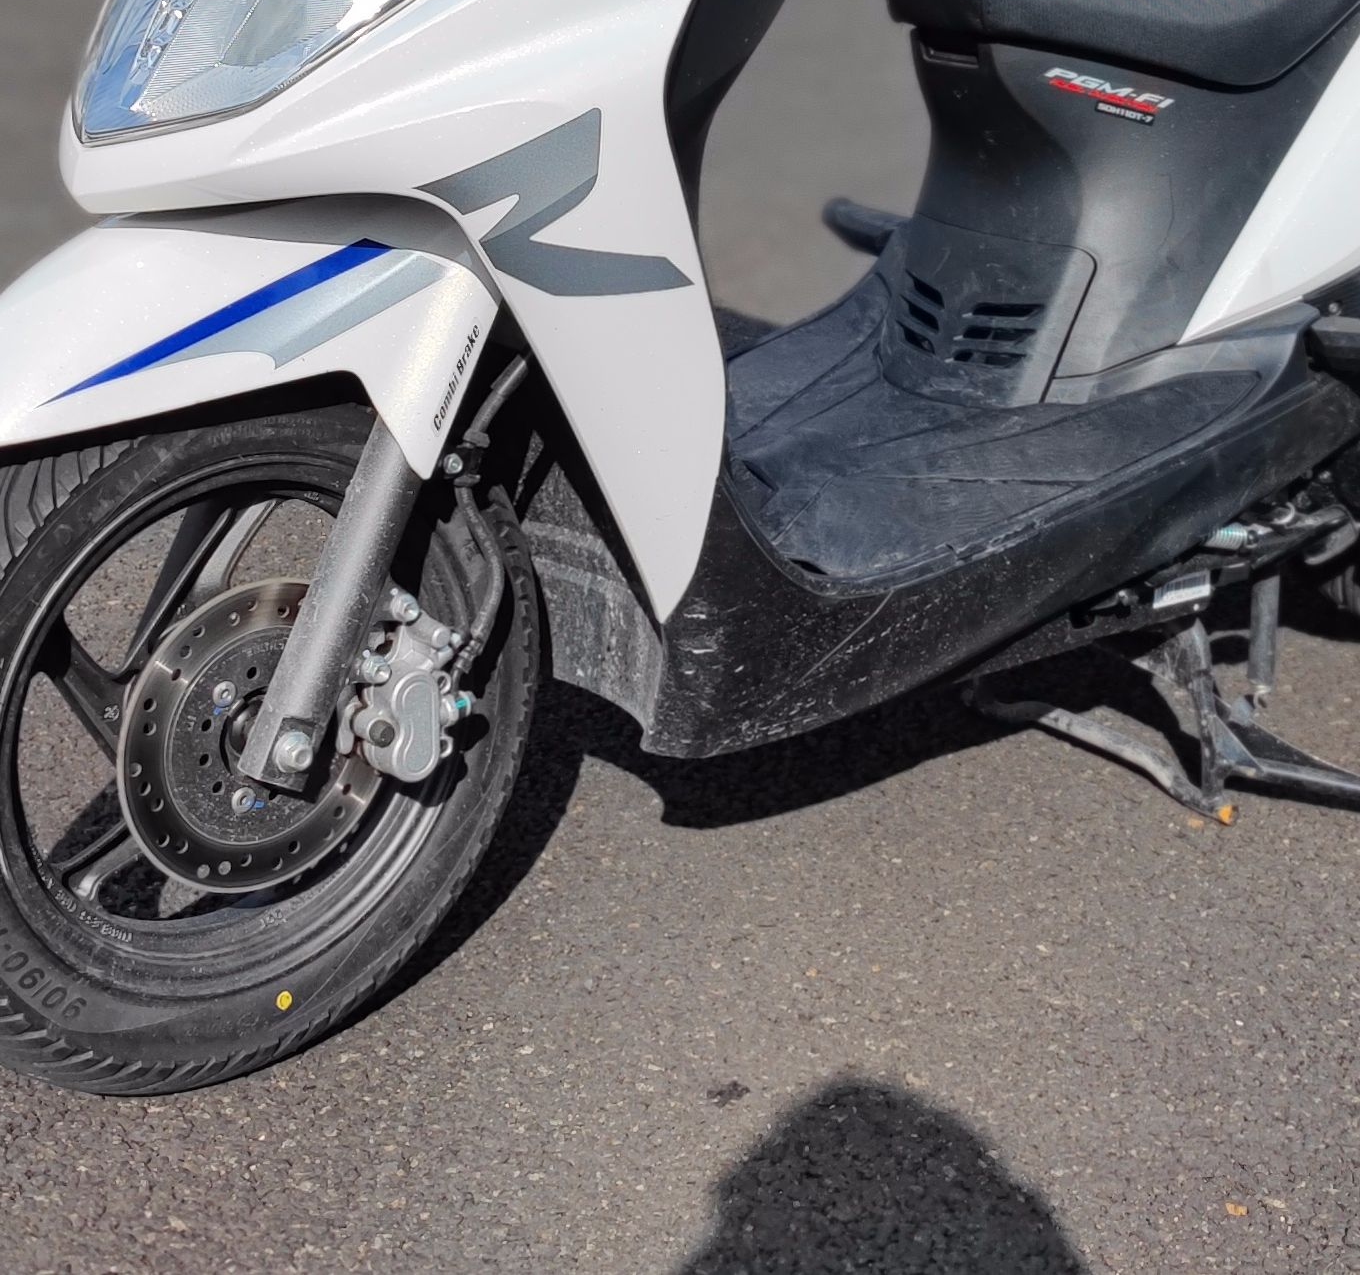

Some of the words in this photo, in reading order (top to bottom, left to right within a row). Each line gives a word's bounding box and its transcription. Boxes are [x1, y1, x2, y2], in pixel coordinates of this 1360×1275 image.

[1044, 67, 1175, 108] PGM-FI
[433, 372, 459, 431] Combi
[456, 325, 480, 376] Brake
